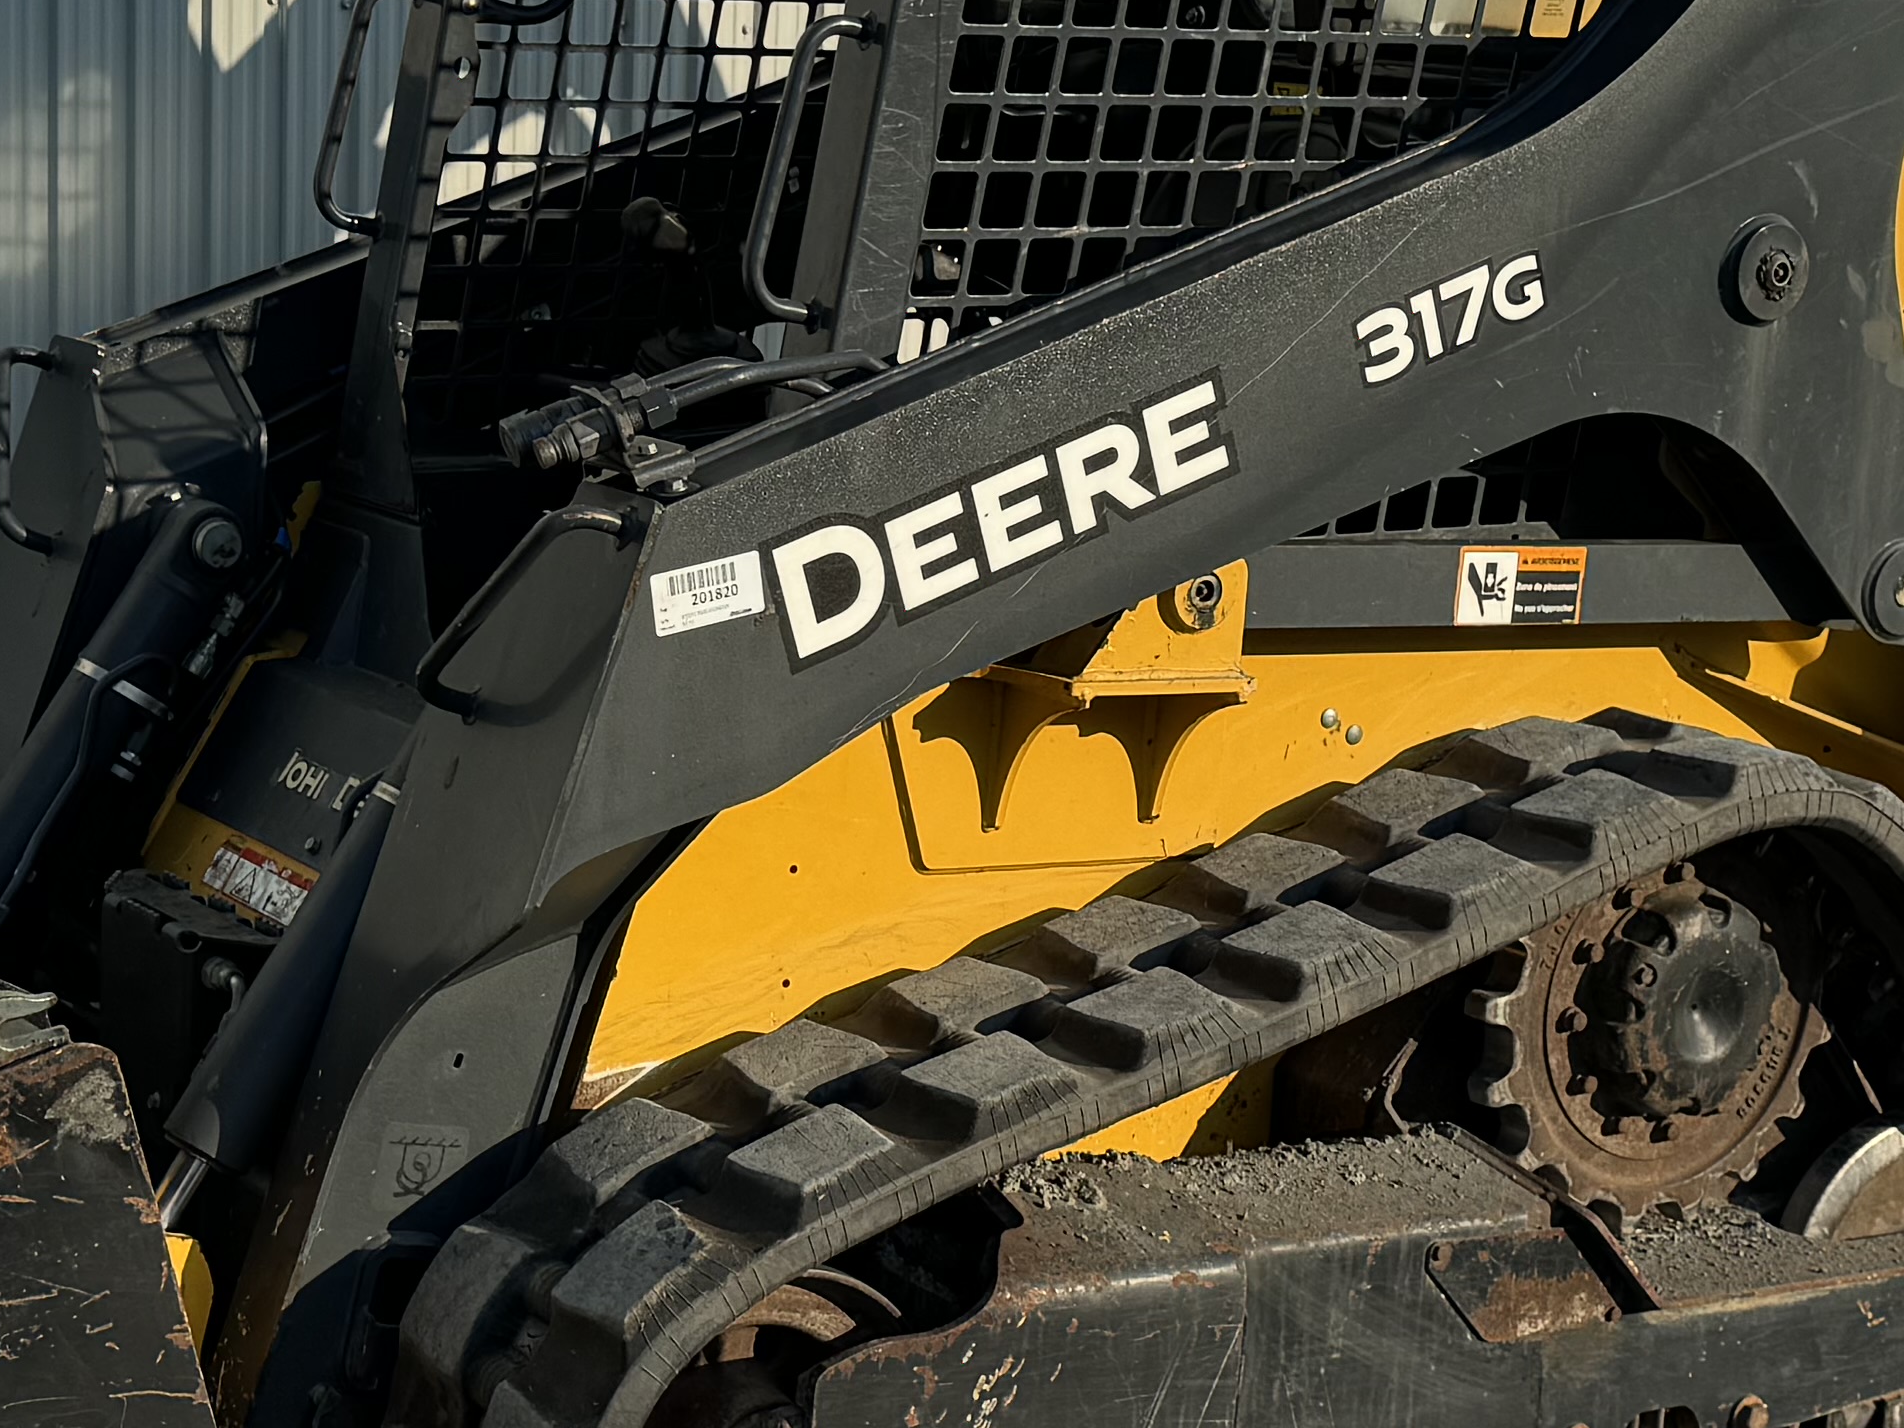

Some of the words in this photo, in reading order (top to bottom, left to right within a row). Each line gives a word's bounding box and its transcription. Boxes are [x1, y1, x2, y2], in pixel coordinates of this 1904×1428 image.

[1356, 254, 1545, 383] 317G
[771, 380, 1230, 659] DEERE
[691, 583, 739, 606] 201820
